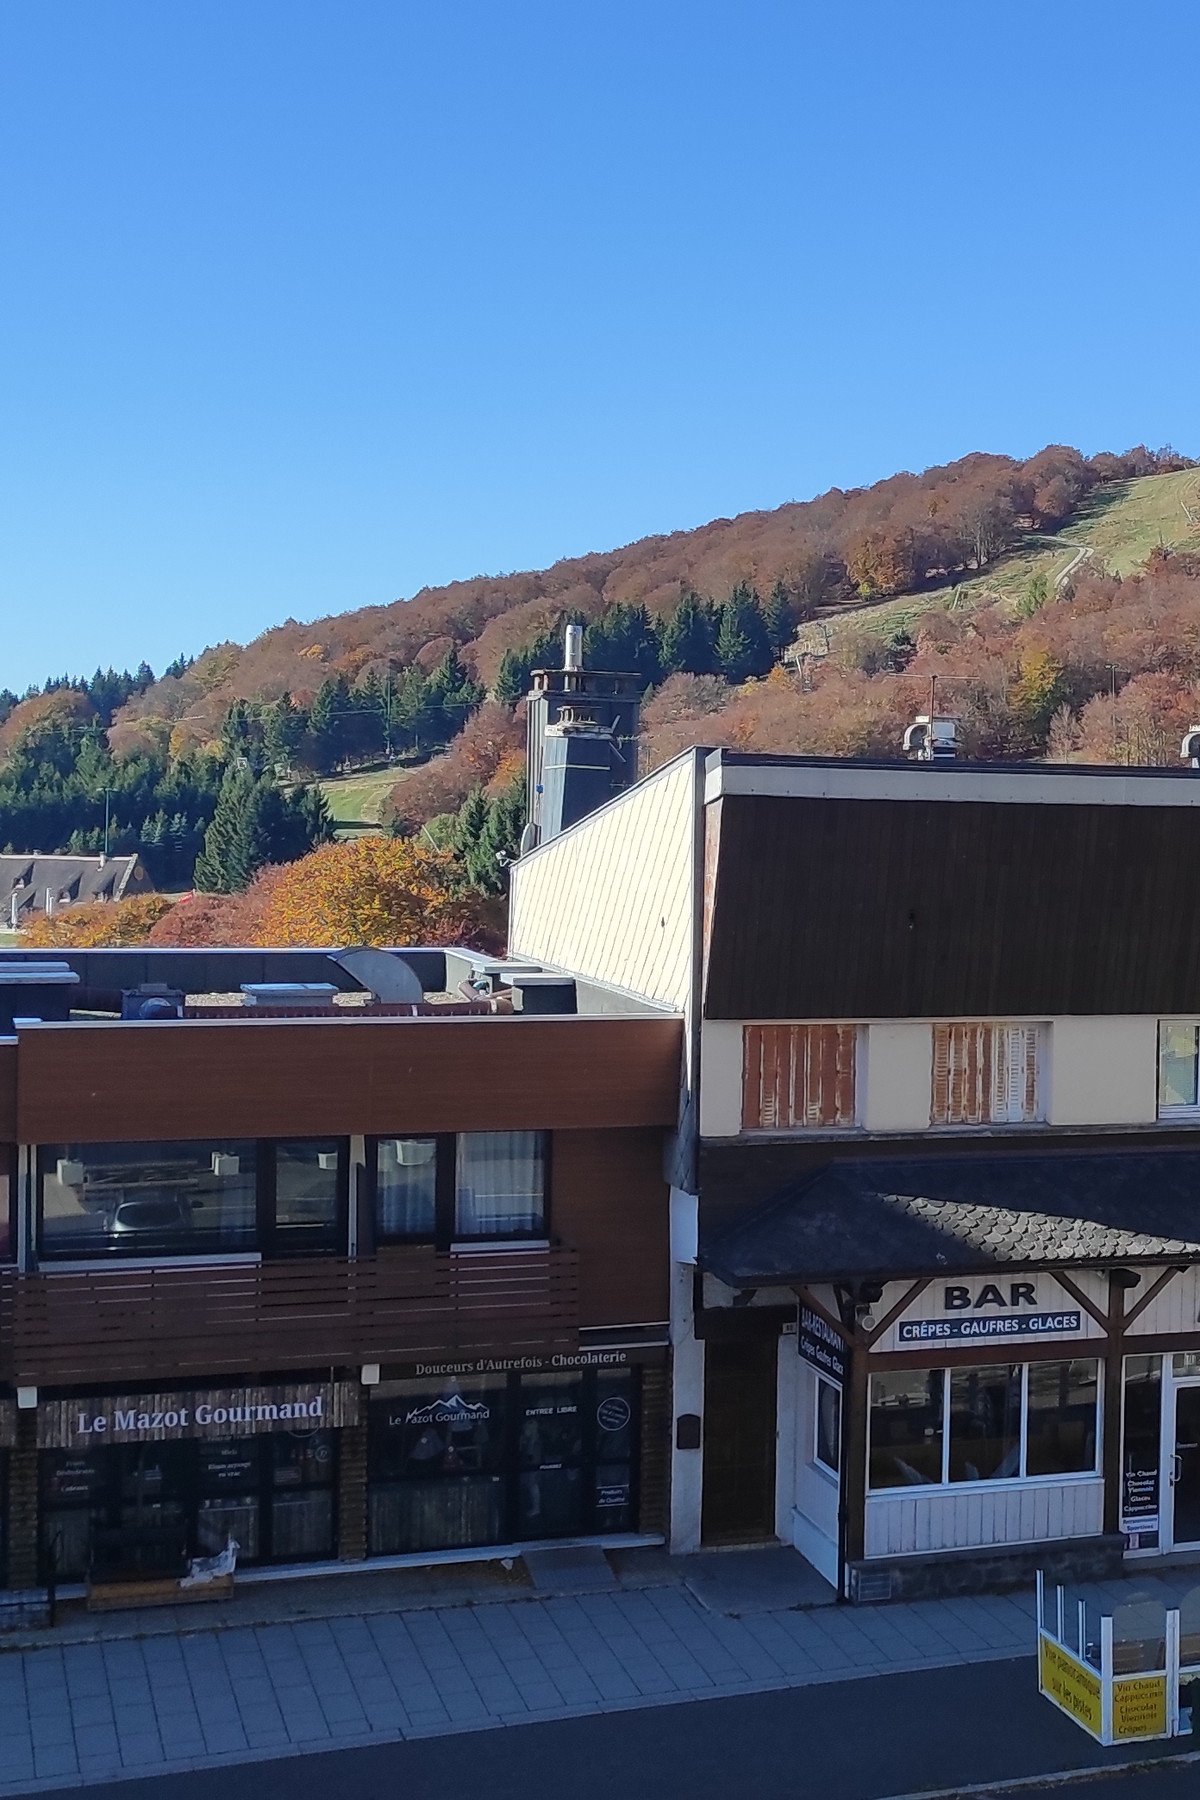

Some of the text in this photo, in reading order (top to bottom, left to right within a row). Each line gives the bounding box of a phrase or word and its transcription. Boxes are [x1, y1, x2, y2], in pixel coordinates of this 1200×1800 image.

[944, 1282, 1038, 1311] BAR
[902, 1321, 951, 1338] CRÊPES
[960, 1319, 1019, 1334] GAUFRES
[1028, 1315, 1078, 1330] GLACES
[415, 1360, 474, 1376] Douceurs
[476, 1356, 543, 1371] d'Autrefois
[551, 1351, 627, 1366] Chocolaterie
[77, 1396, 324, 1435] Le Mazot Gourmand
[389, 1415, 402, 1426] Le
[435, 1408, 490, 1423] Gourmand
